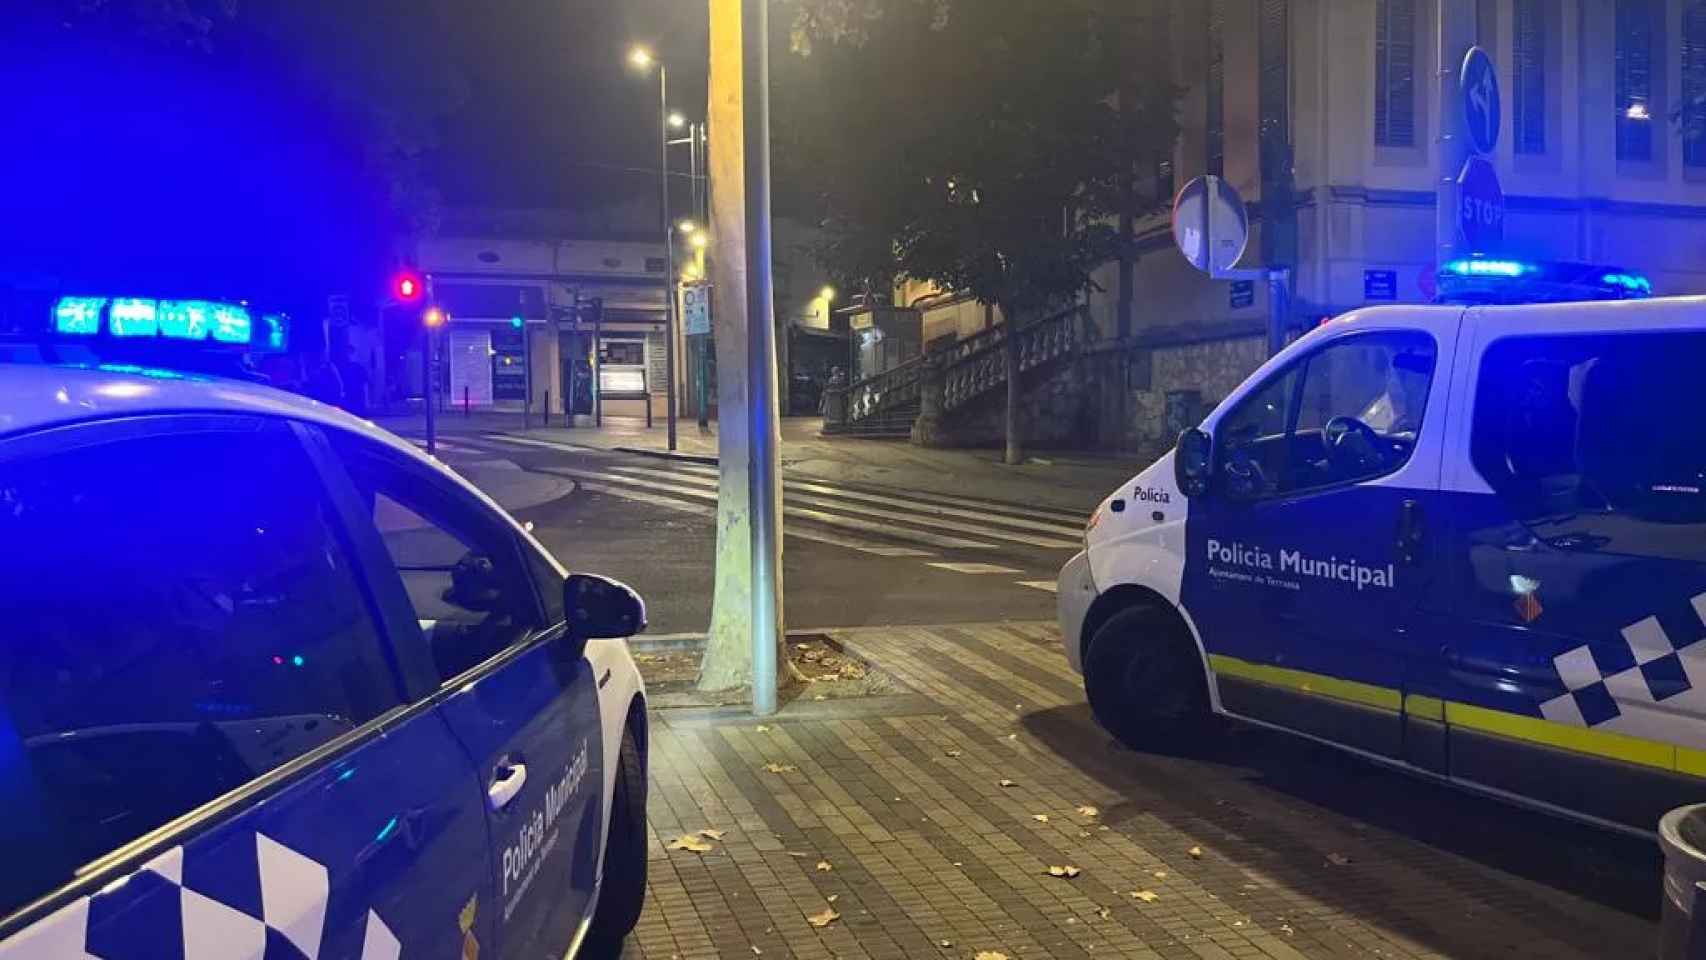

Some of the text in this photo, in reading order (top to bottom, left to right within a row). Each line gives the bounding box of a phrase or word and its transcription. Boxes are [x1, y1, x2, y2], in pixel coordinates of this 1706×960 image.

[1463, 196, 1502, 227] STOP
[1134, 486, 1170, 504] Policia
[1207, 539, 1394, 590] Policia Municipal
[502, 809, 545, 896] Policia
